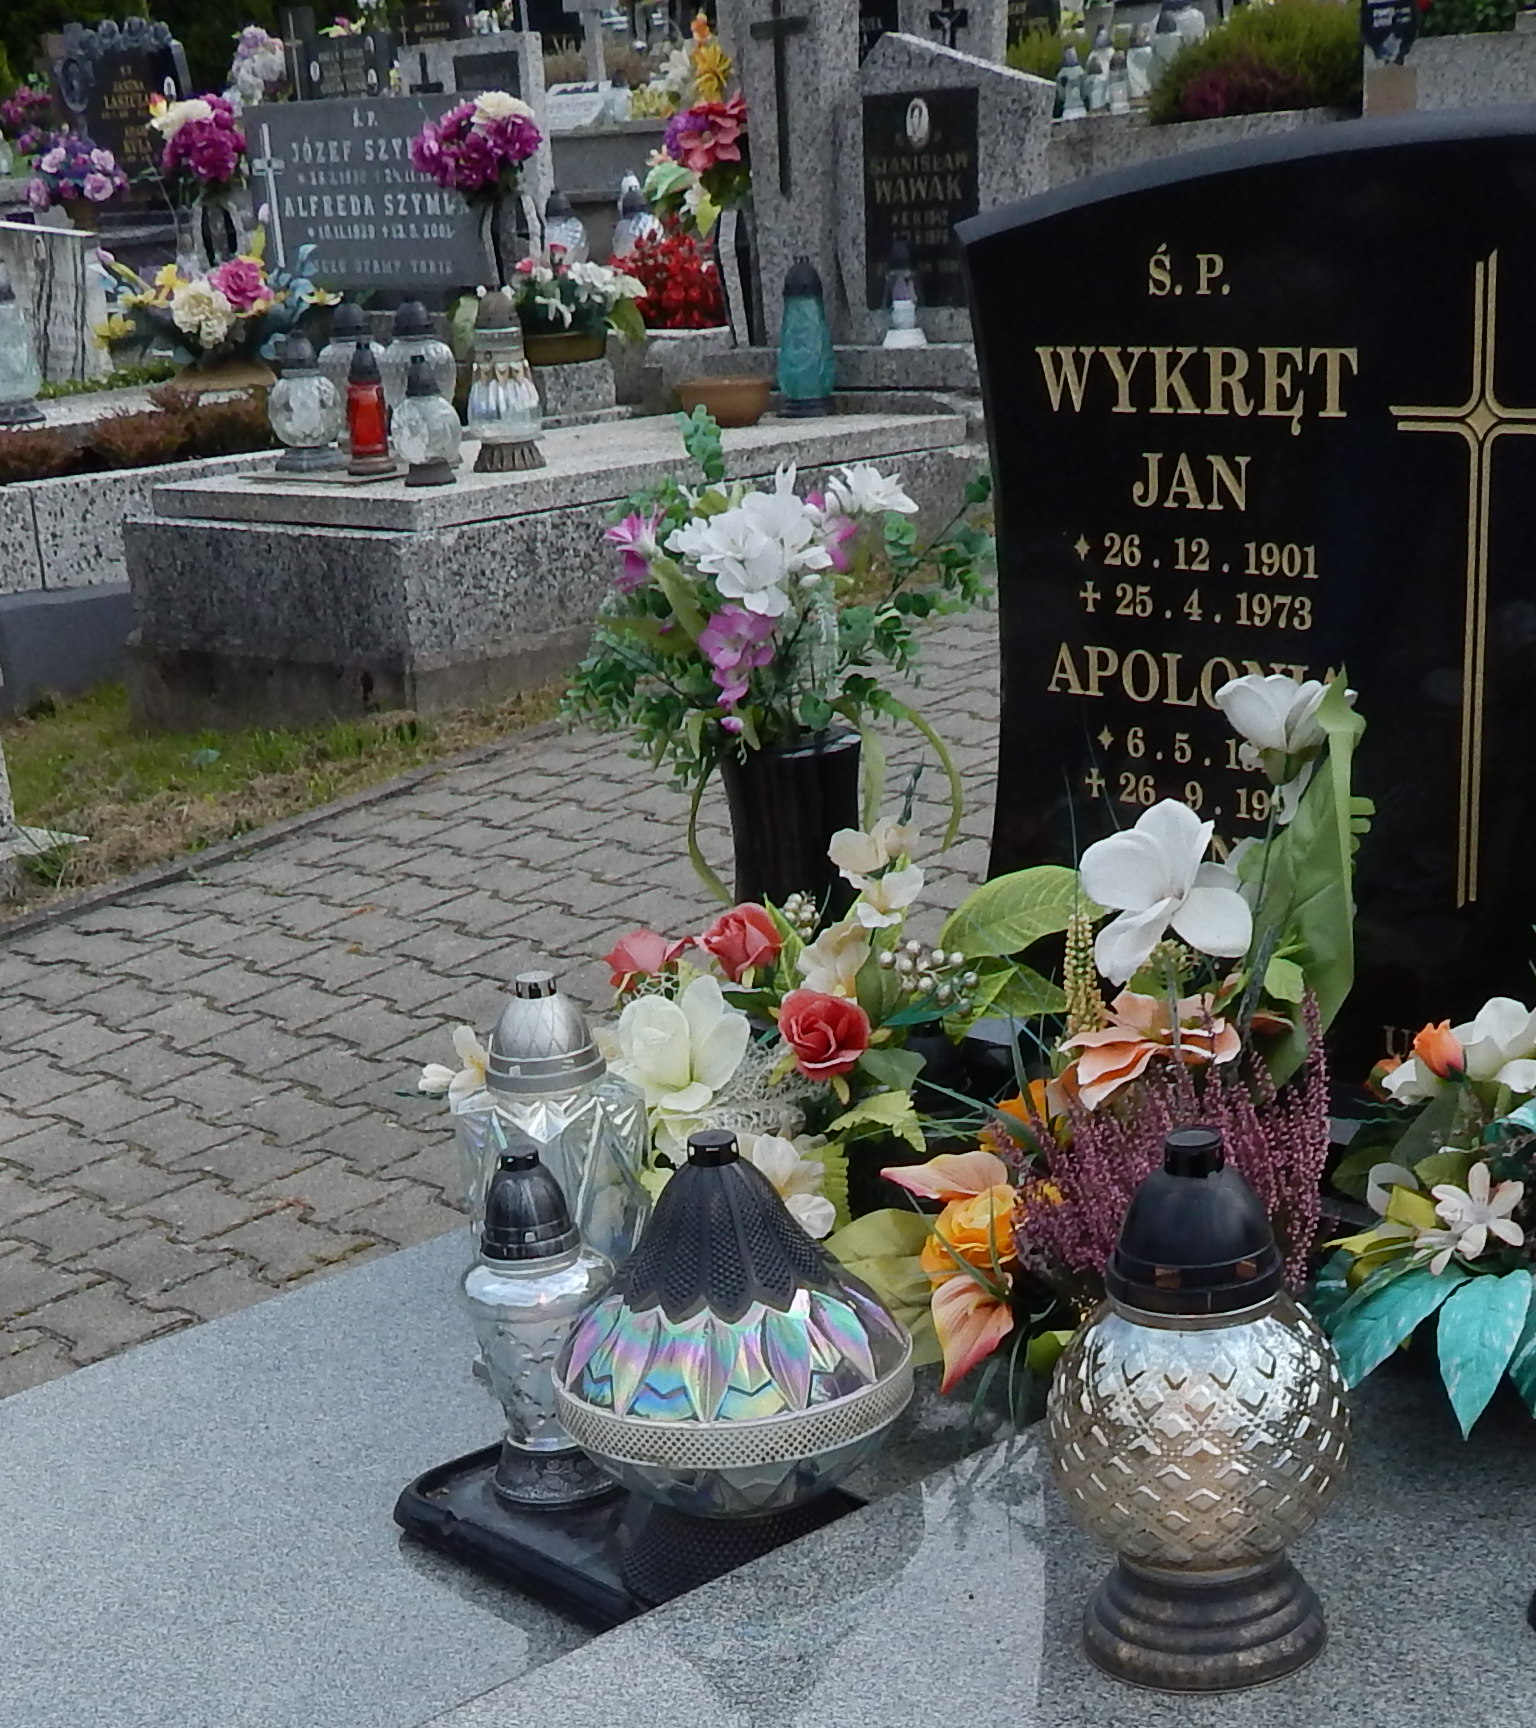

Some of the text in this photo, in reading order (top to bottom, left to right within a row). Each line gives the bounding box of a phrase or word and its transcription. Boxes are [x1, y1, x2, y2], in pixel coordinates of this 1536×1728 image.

[291, 136, 352, 163] JÓZEF
[285, 194, 375, 217] ALFREDA
[874, 175, 962, 204] WAWAK
[1149, 243, 1230, 296] Ś. P.
[1035, 346, 1358, 436] WYKRĘT
[1132, 452, 1252, 511] JAN
[1047, 642, 1340, 712] APOLO
